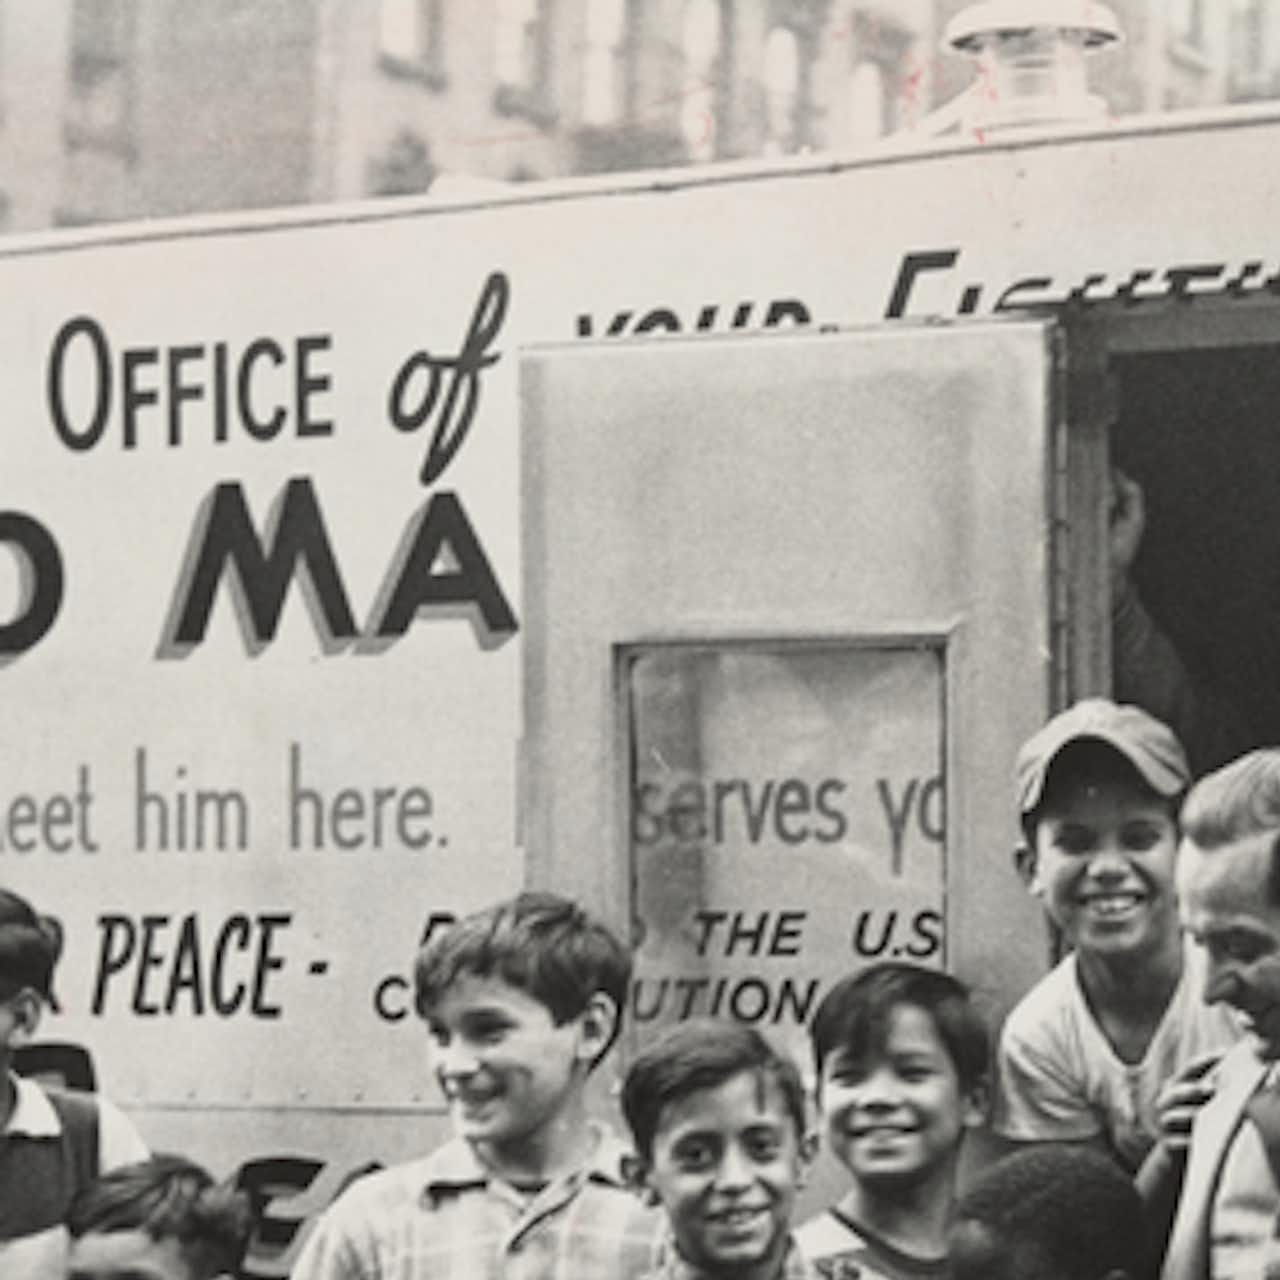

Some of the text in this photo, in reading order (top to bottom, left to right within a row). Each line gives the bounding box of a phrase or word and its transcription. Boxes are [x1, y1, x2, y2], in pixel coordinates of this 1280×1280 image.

[48, 316, 335, 451] OFFICE
[388, 271, 510, 486] of
[0, 764, 99, 852] eet
[136, 746, 249, 852] him
[289, 743, 449, 850] here.
[633, 777, 848, 845] serves
[694, 910, 808, 957] THE
